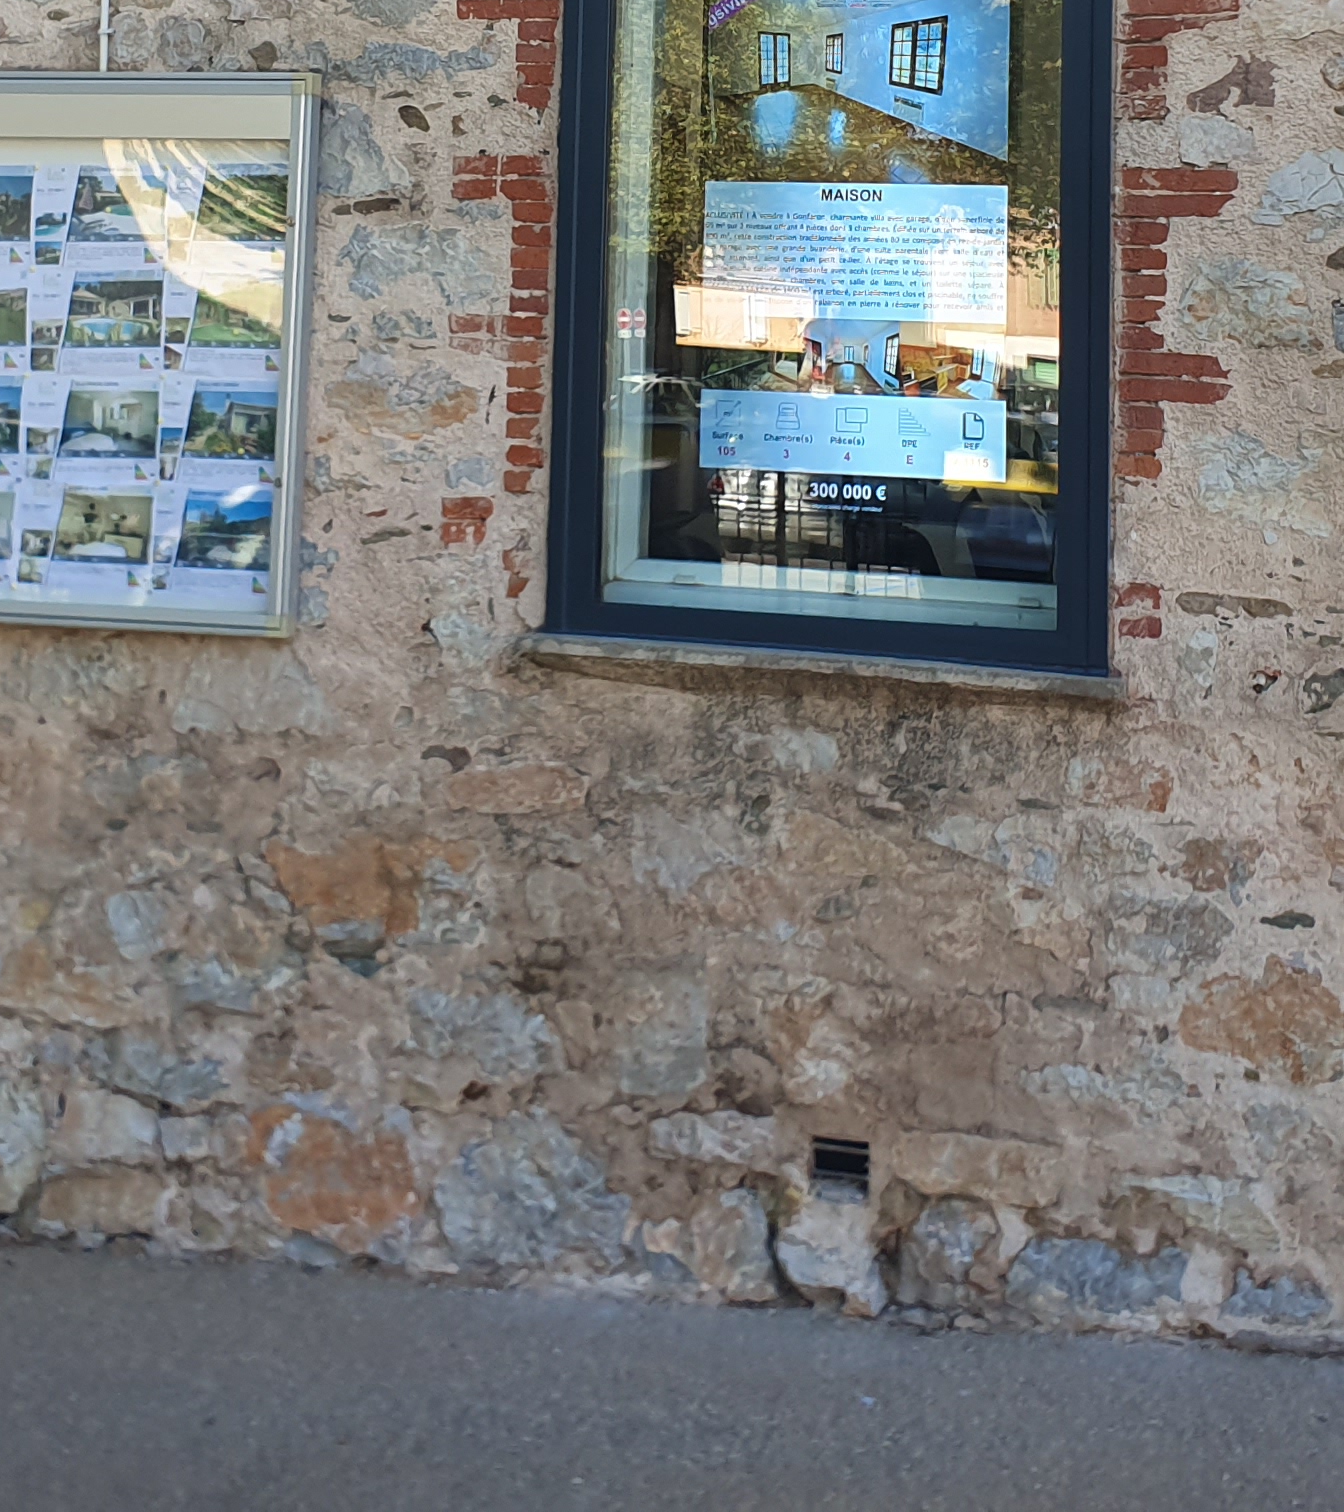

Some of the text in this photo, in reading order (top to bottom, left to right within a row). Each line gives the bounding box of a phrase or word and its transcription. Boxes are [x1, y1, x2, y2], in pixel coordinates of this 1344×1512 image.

[820, 188, 883, 202] MAISON
[717, 445, 914, 465] 105 3 4 E
[809, 482, 887, 501] 300 000 €
